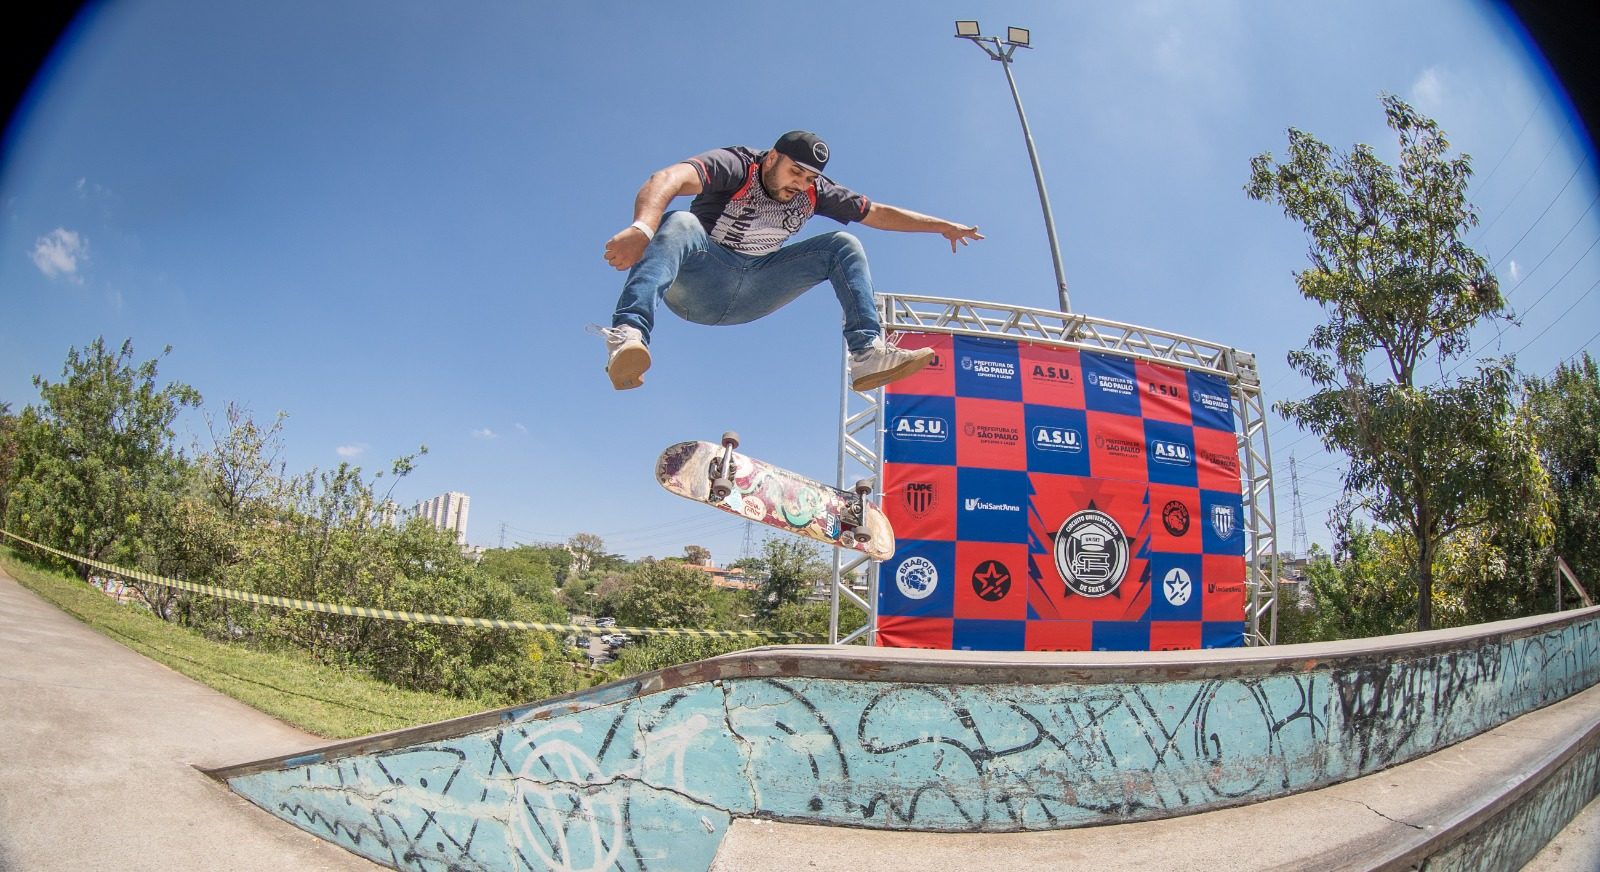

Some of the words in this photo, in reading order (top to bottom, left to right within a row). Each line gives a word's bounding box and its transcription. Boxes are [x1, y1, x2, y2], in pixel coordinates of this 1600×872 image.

[974, 360, 1006, 368] PREFEITURA
[974, 364, 990, 372] SÃO
[991, 366, 1015, 375] PAULO
[1033, 365, 1073, 380] A.S.U.
[1099, 380, 1113, 388] SÃO
[1113, 382, 1134, 391] PAULO
[1148, 383, 1181, 398] A.S.U.
[896, 419, 945, 434] A.S.U.
[977, 425, 1009, 433] PREFEITURA
[977, 430, 993, 439] SÃO
[994, 432, 1019, 441] PAULO
[1037, 429, 1080, 446] A.S.U.
[1106, 443, 1119, 451] SÃO
[1120, 446, 1141, 454] PAULO
[1155, 443, 1189, 459] A.S.U.
[907, 483, 932, 491] FUPE
[1065, 515, 1085, 533] CIRCUITO
[1085, 514, 1119, 536] UNIVERSITÁRIO
[899, 558, 935, 575] BRABOIS
[1079, 584, 1087, 592] DE
[1087, 584, 1106, 593] SKATE
